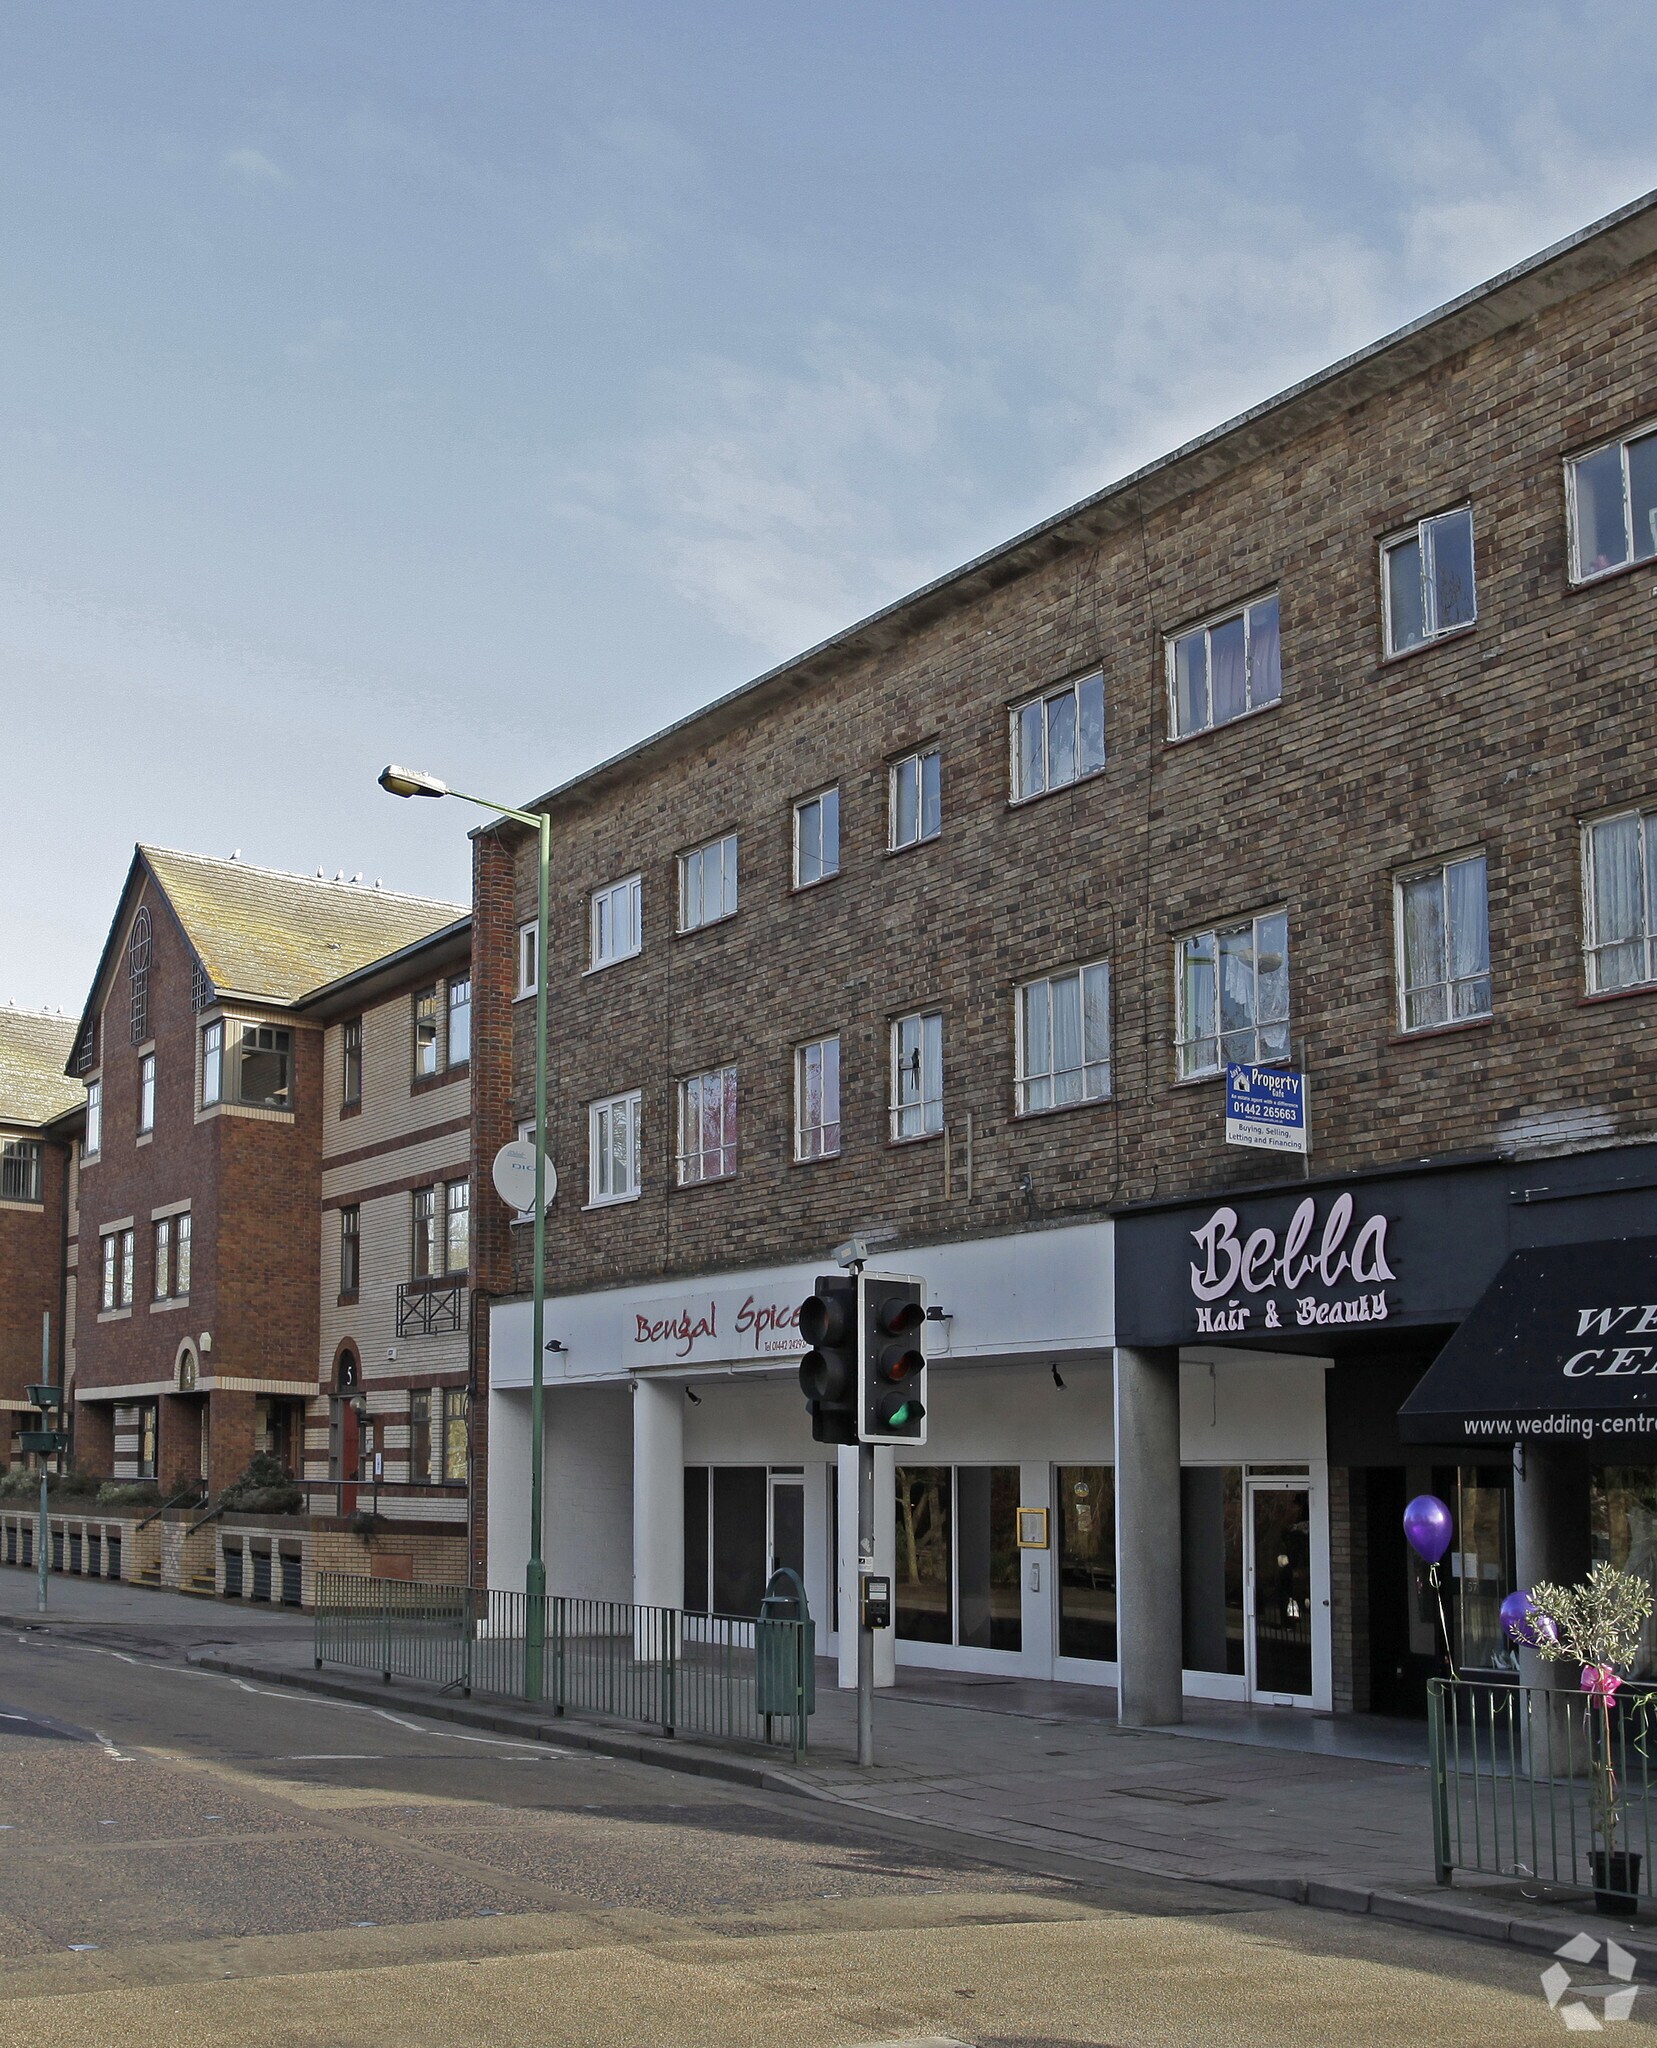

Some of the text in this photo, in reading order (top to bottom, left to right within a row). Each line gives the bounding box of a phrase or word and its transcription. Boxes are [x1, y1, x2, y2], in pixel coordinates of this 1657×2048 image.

[1252, 1068, 1299, 1094] Property
[1234, 1101, 1261, 1116] 01442
[1263, 1106, 1297, 1121] 265663
[1229, 1133, 1301, 1149] Letting and Financing
[1239, 1124, 1291, 1138] Buying, Selling,
[1190, 1192, 1397, 1302] Bella
[1196, 1289, 1389, 1333] Hair & Beauty
[634, 1300, 718, 1358] Bengal
[1563, 1346, 1657, 1378] CE
[346, 1366, 352, 1385] 5
